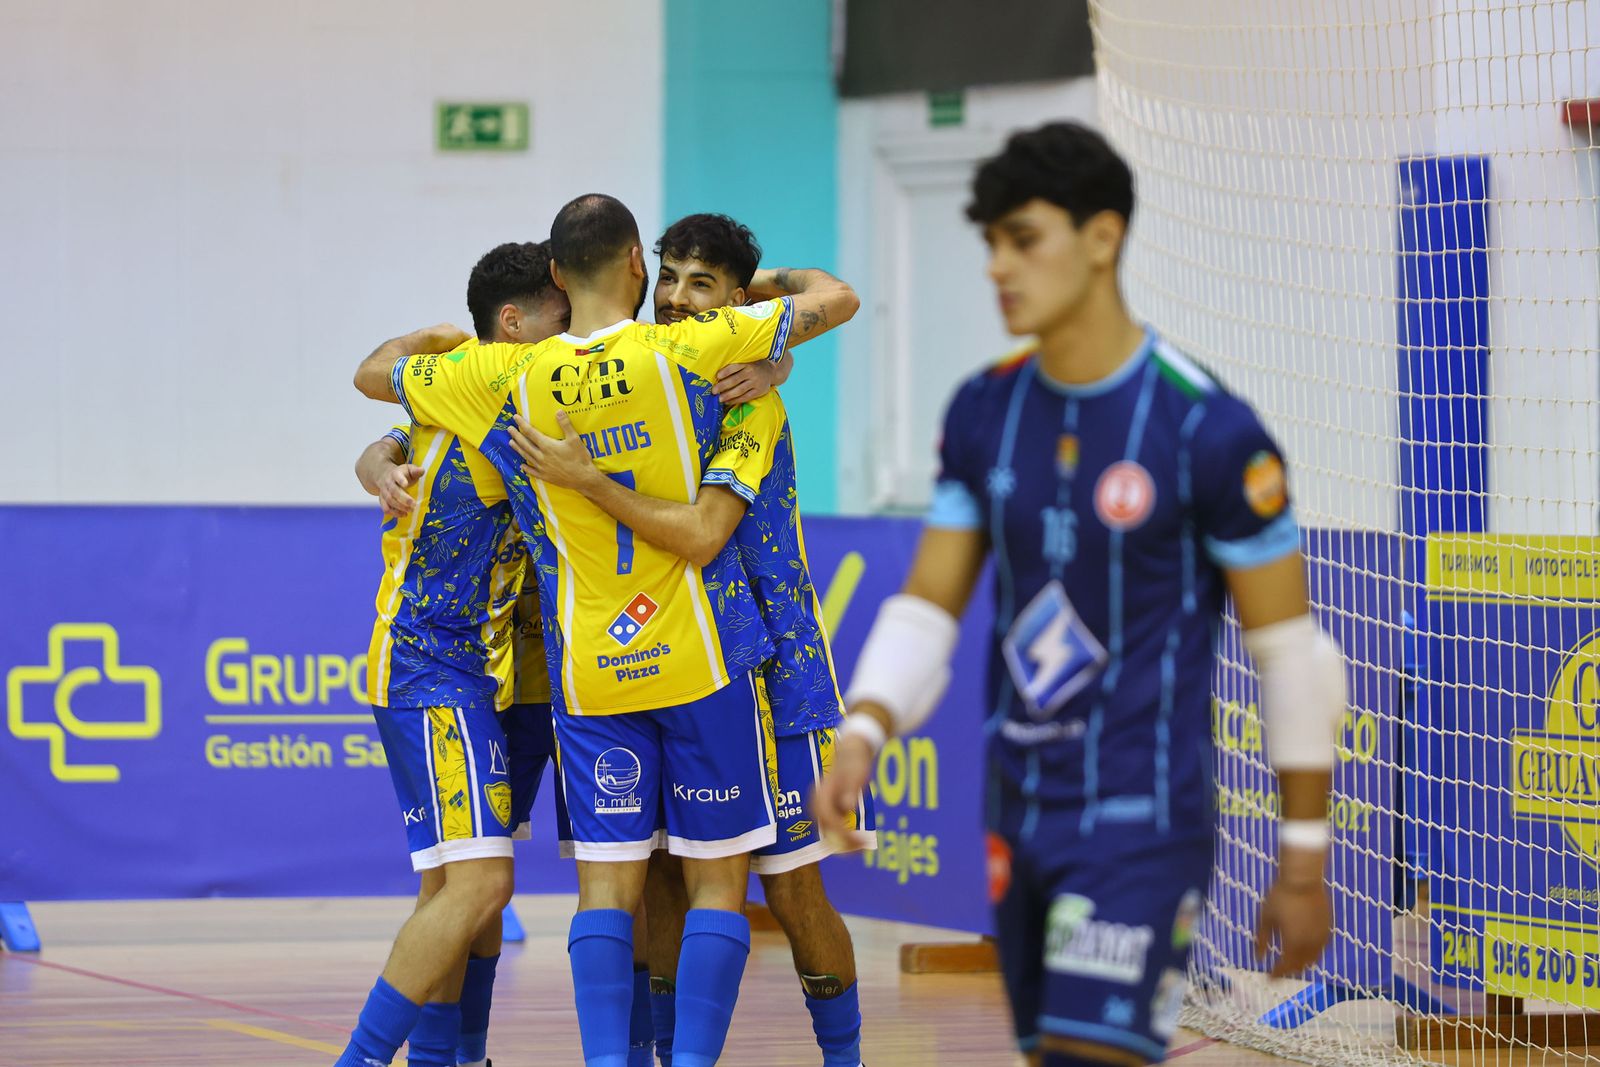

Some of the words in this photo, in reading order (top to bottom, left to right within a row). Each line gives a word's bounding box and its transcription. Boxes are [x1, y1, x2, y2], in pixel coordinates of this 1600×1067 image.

[1441, 553, 1498, 575] TURISMOS
[597, 642, 671, 669] Domino's
[615, 665, 660, 682] Pizza
[205, 734, 331, 768] Gestión
[594, 792, 605, 807] la
[610, 792, 641, 807] mirilla
[673, 782, 741, 802] Kraus
[790, 830, 811, 842] umbro
[1493, 939, 1531, 979] 956
[1536, 945, 1576, 985] 200
[1583, 951, 1600, 988] 5
